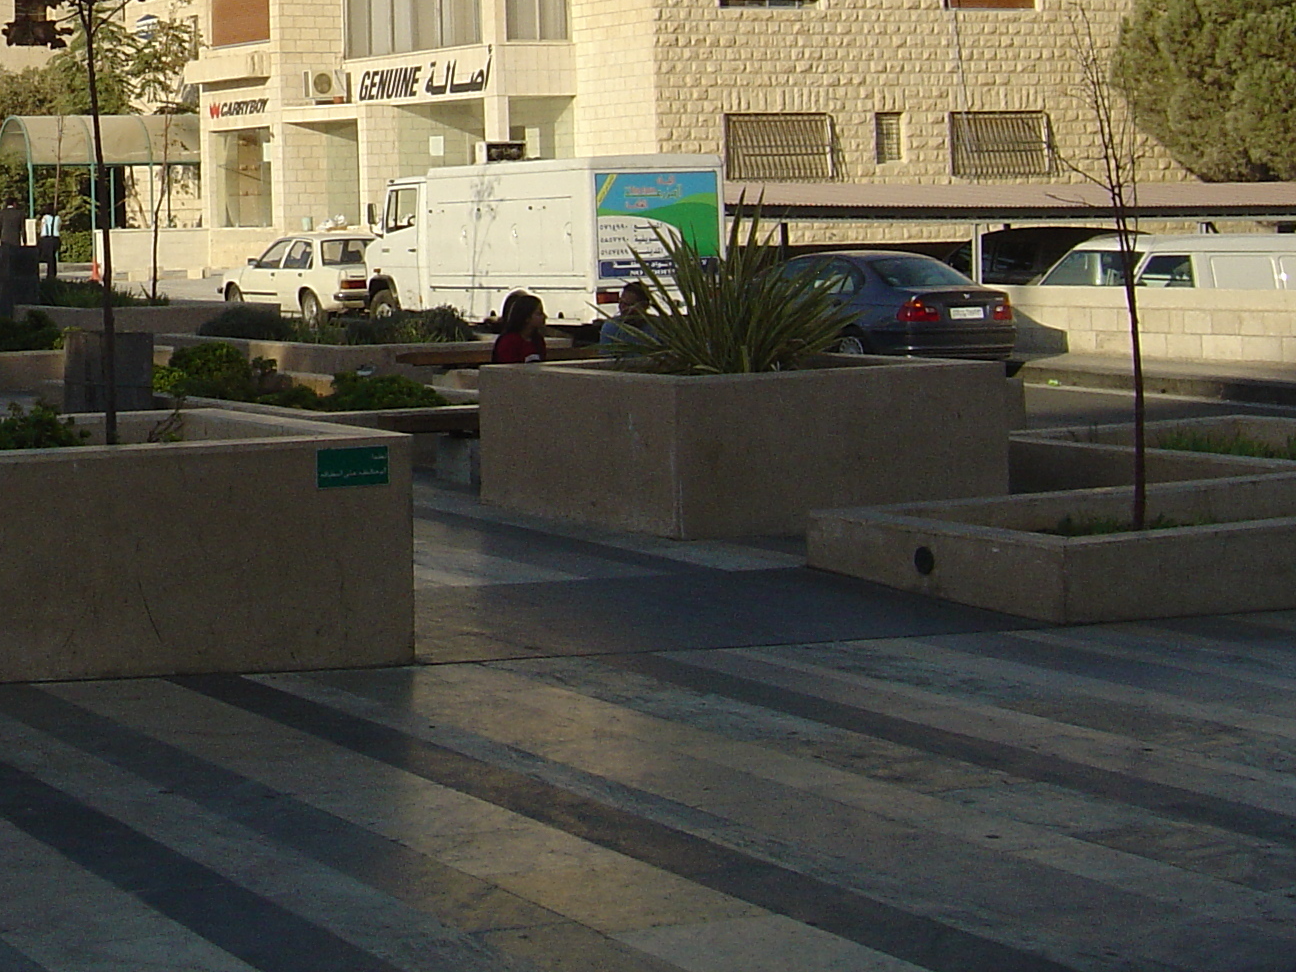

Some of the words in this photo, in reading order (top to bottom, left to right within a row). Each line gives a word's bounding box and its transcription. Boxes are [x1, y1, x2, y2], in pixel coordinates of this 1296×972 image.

[359, 65, 422, 101] GENUINE
[425, 44, 492, 95] أصالة
[221, 98, 269, 117] CARRYBOY
